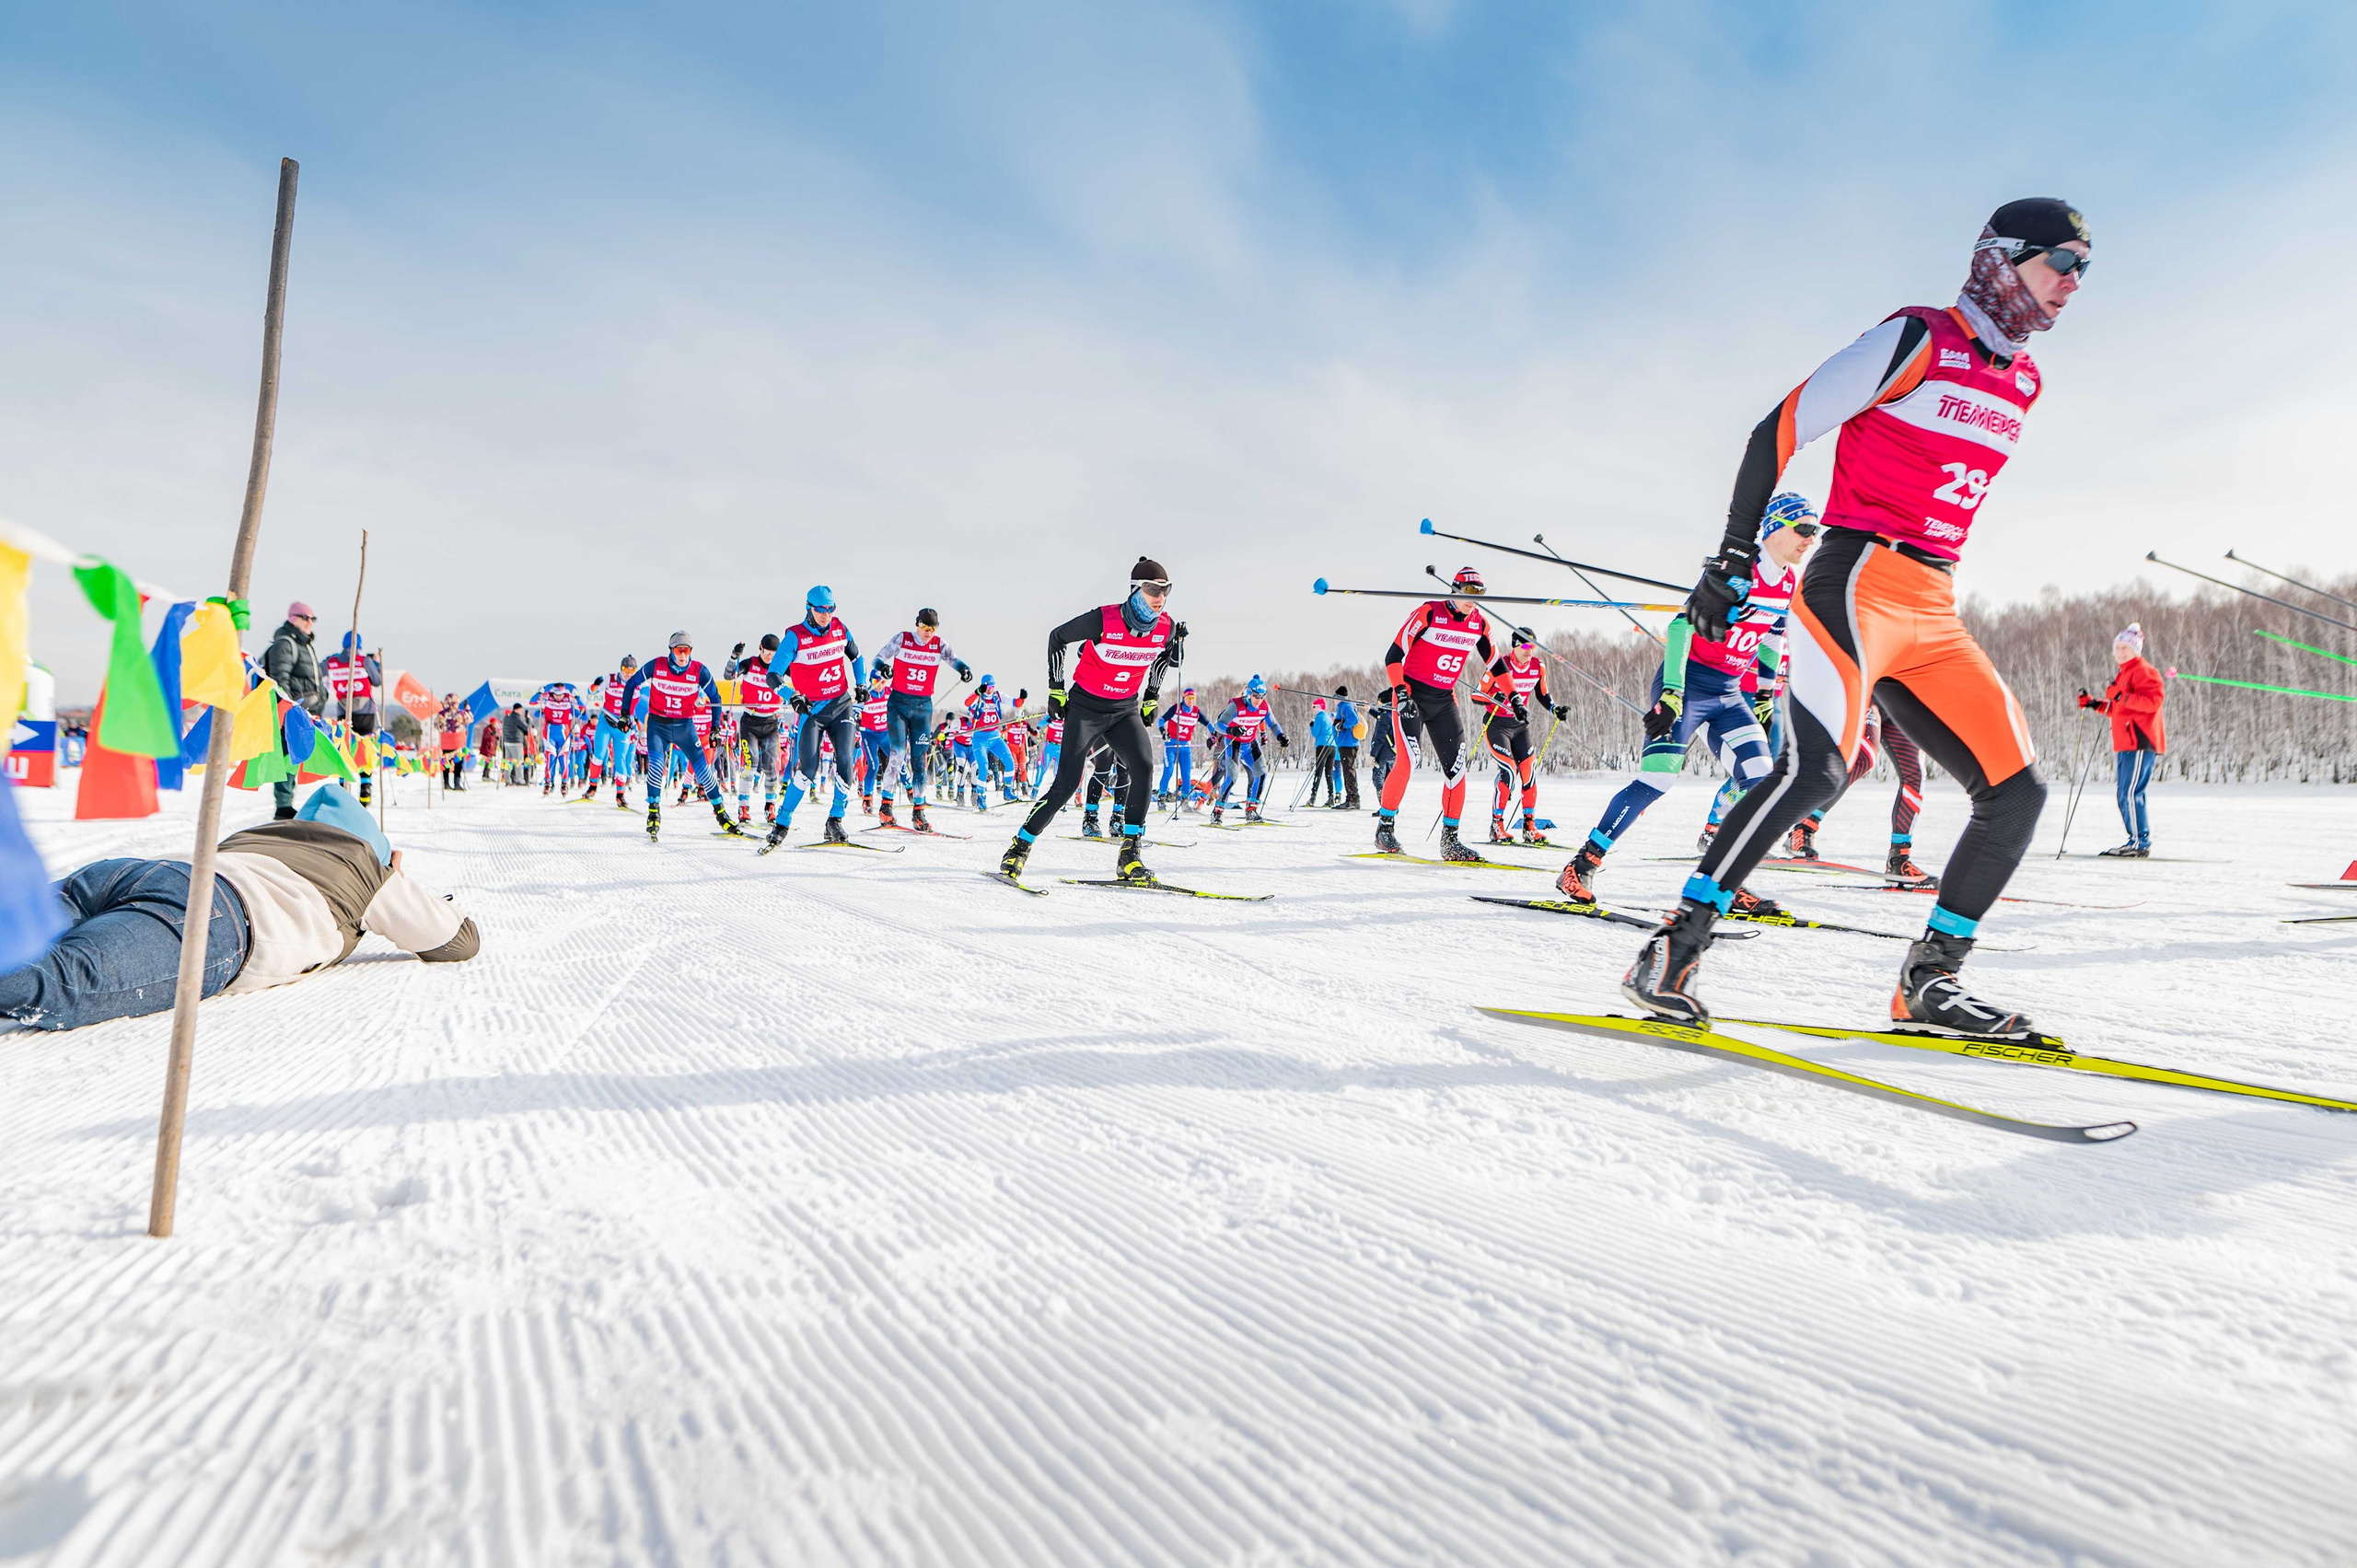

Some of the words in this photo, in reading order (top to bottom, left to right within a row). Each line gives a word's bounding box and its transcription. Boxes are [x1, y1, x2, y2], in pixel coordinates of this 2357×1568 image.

[1933, 462, 1988, 509] 29
[1436, 654, 1463, 673] 65
[819, 665, 842, 682] 43
[907, 668, 927, 681] 38
[1114, 671, 1131, 681] 2
[665, 696, 681, 709] 13
[758, 691, 772, 702] 10
[983, 714, 997, 723] 80
[741, 739, 751, 772] CRAFT
[1450, 742, 1466, 773] TECSO
[1528, 900, 1596, 915] FISCHER
[1724, 912, 1795, 927] SCHER
[1636, 1022, 1703, 1040] FISCHER
[1963, 1042, 2073, 1066] FISCHER
